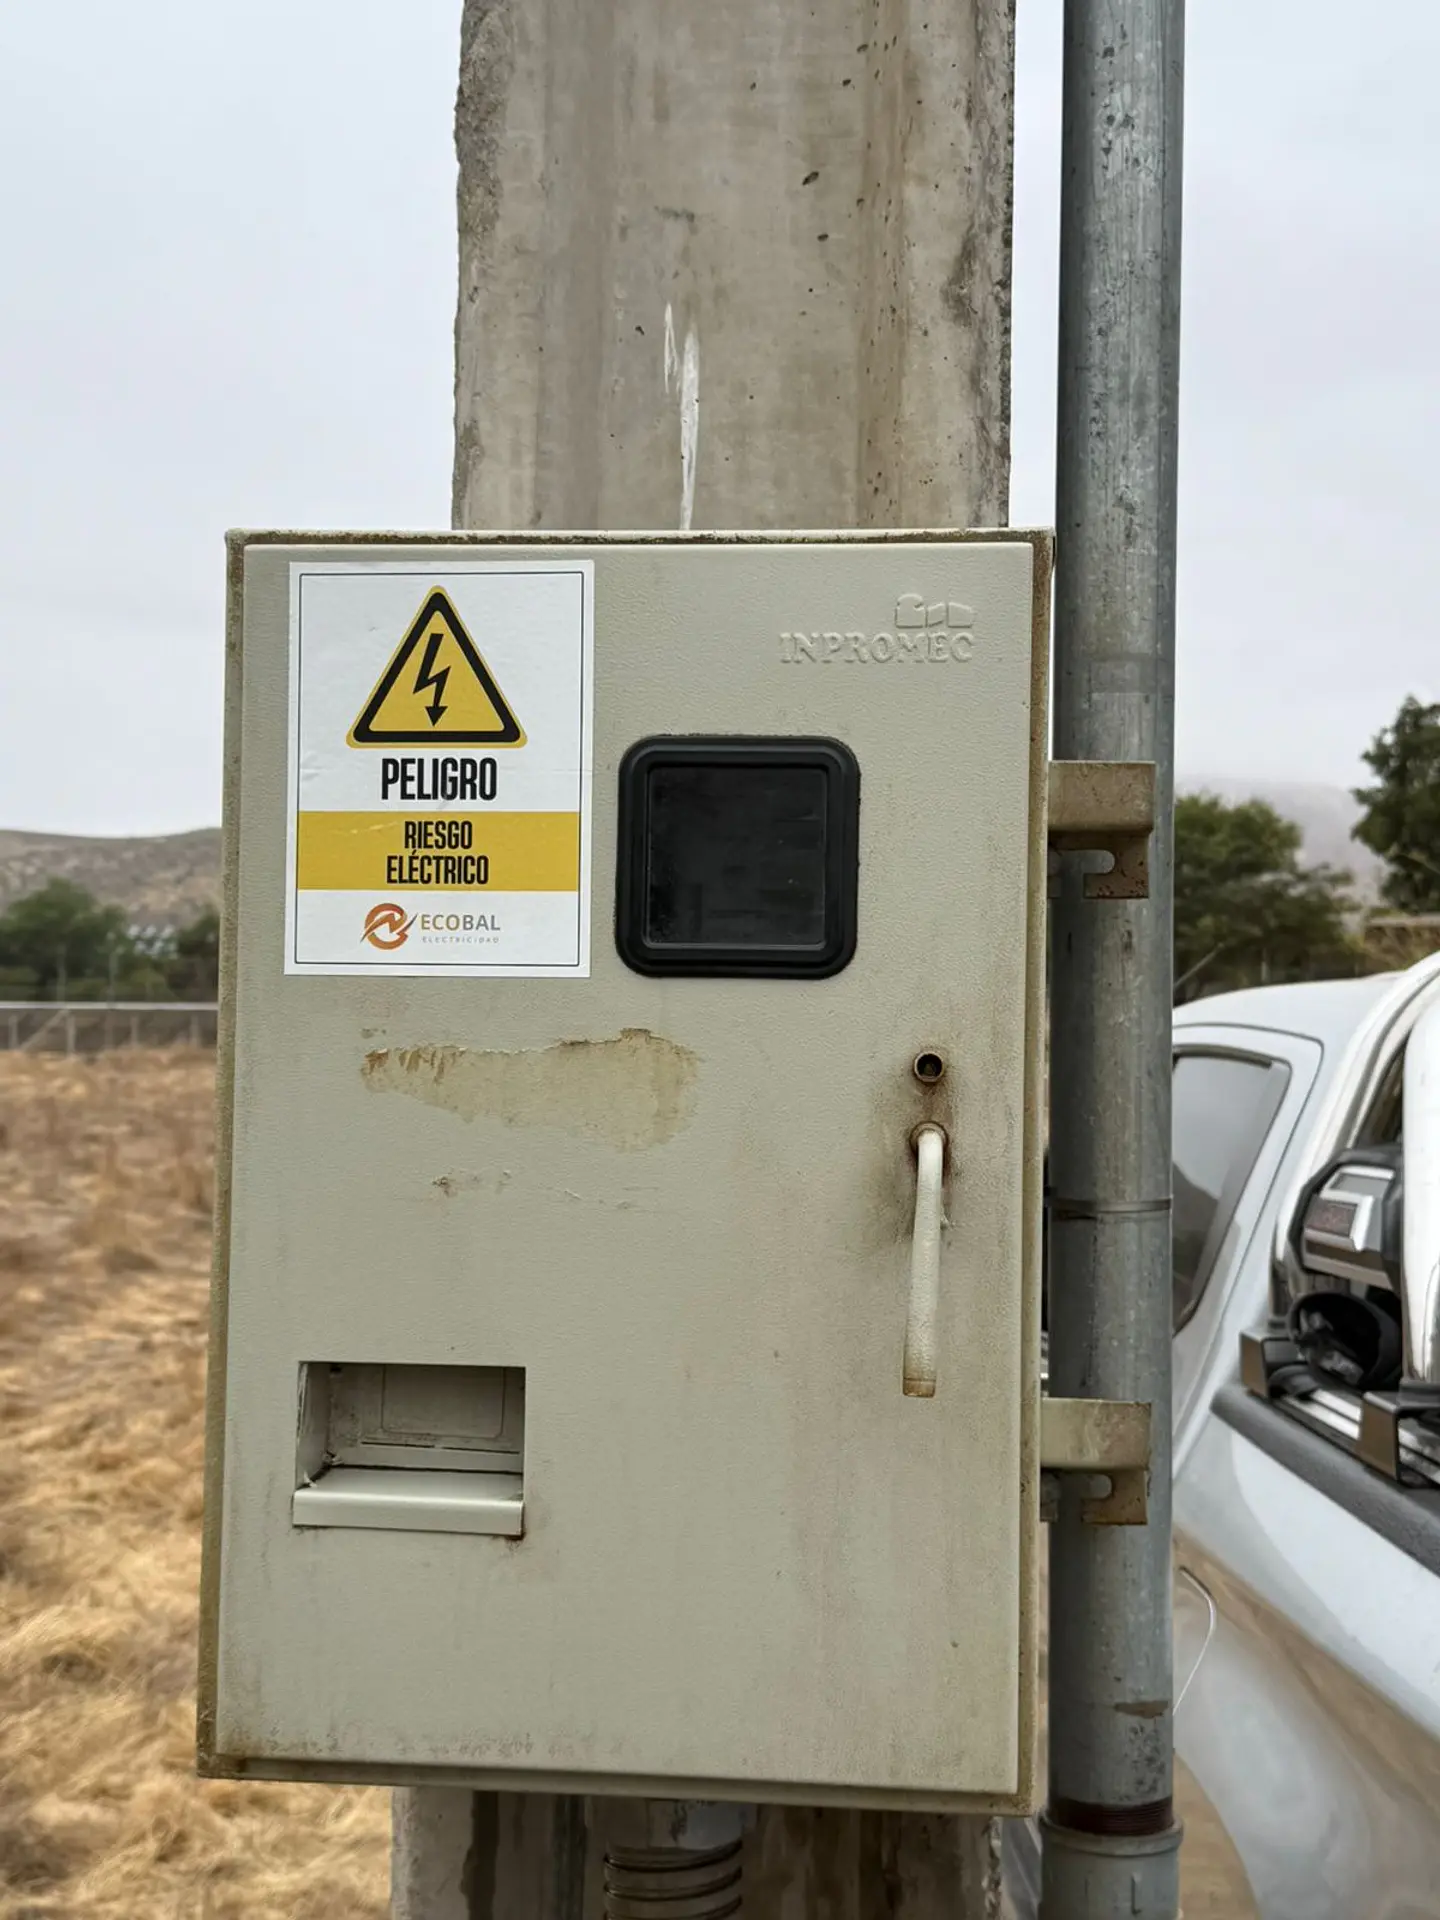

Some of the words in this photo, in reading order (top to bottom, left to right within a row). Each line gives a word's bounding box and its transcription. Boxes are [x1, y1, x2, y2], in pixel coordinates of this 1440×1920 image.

[780, 632, 974, 663] INPROMEC
[381, 757, 497, 801] PELIGRO
[404, 820, 473, 850] RIESGO
[386, 850, 489, 885] ELÉCTRICO
[421, 913, 501, 931] ECOBAL
[422, 936, 500, 944] ELECTRICIDAD
